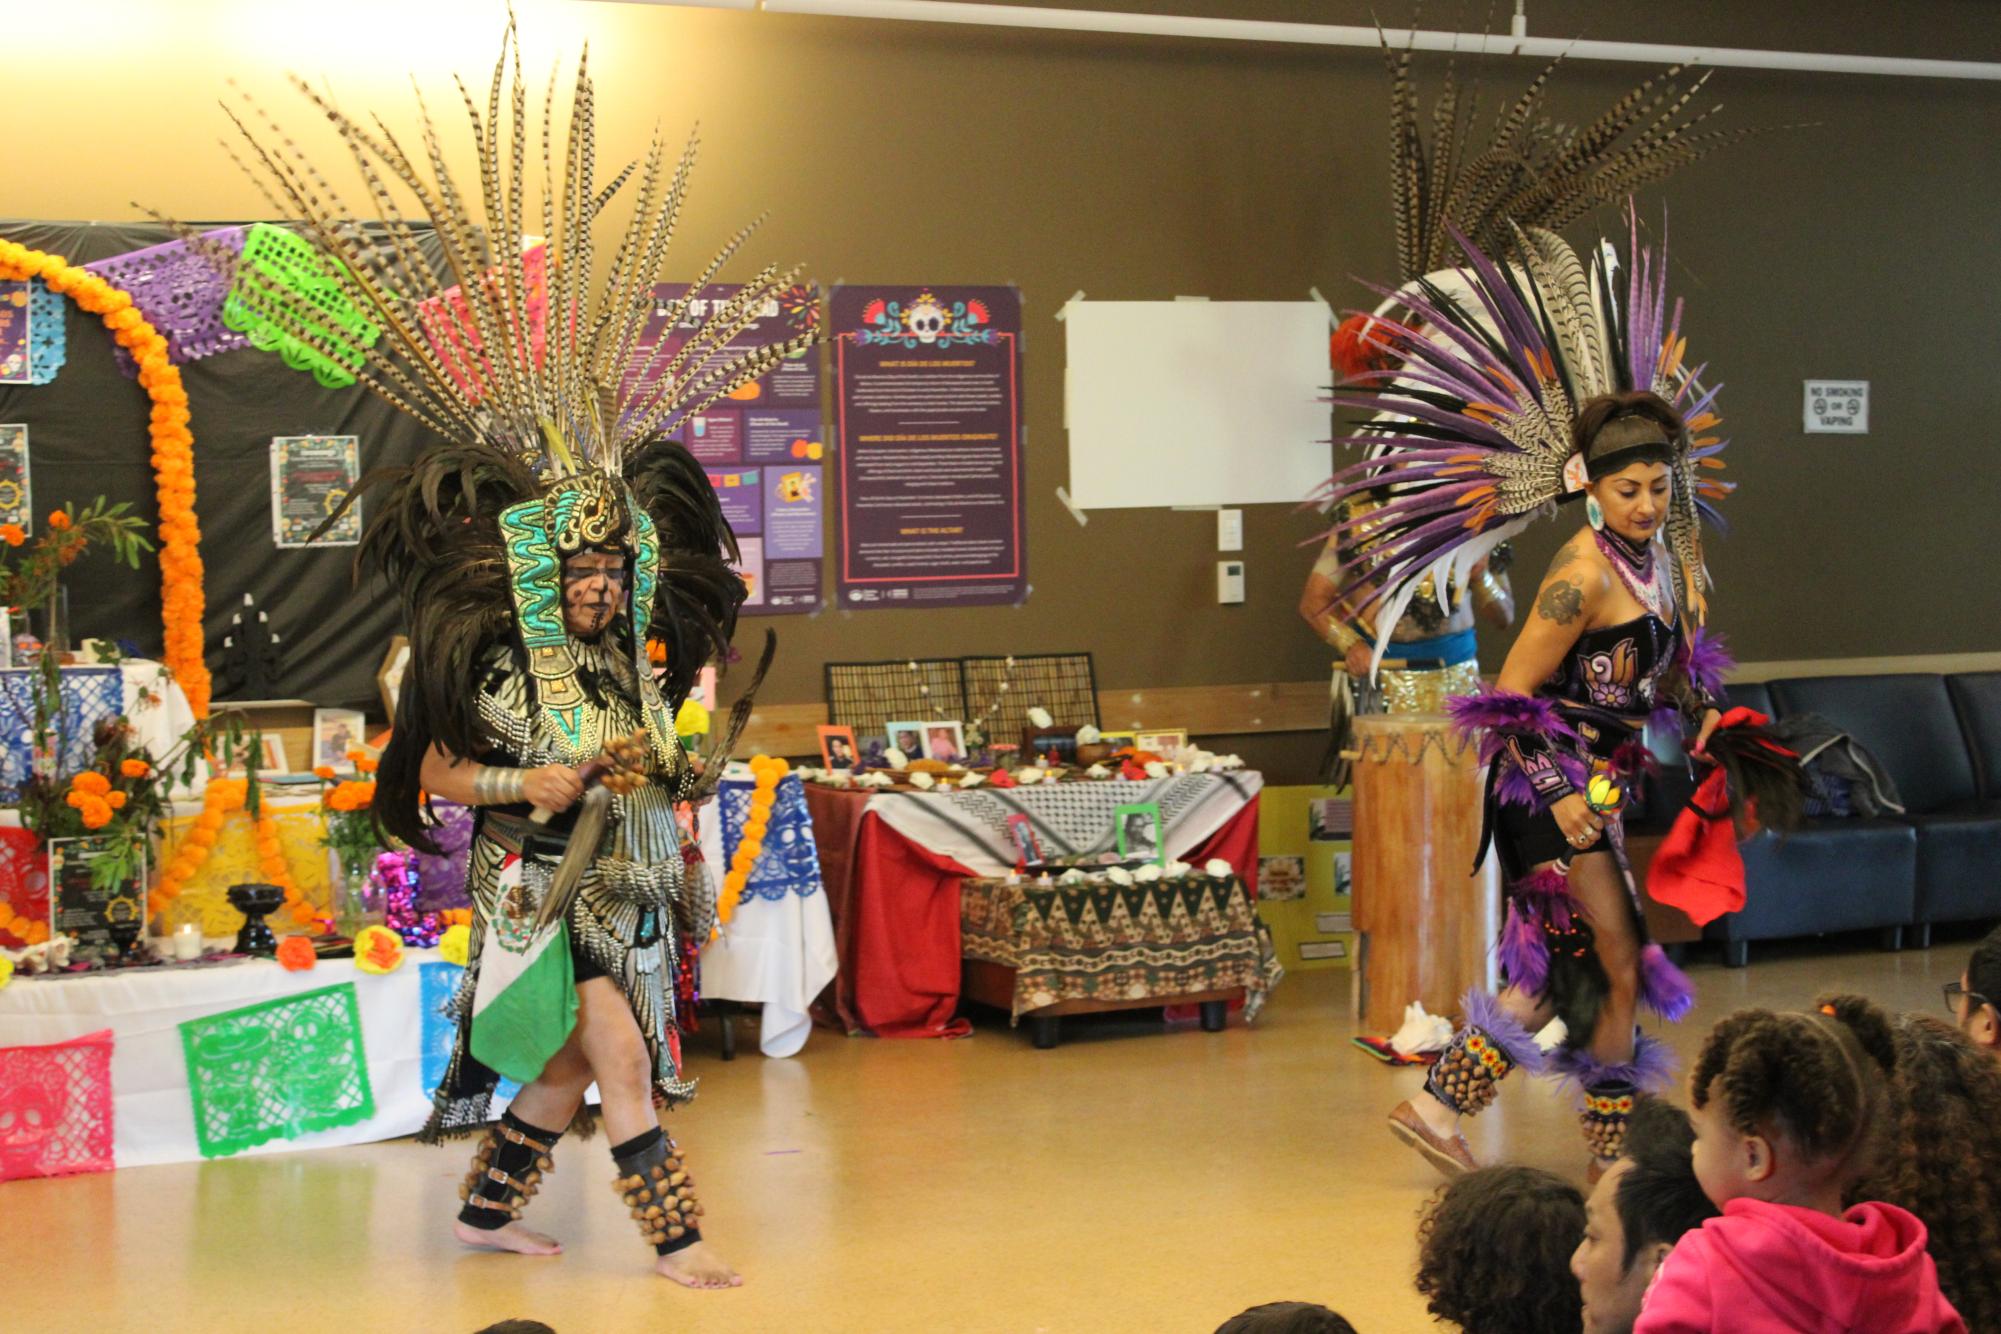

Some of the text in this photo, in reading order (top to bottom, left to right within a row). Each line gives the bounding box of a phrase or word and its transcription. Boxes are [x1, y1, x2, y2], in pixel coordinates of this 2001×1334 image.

[689, 299, 709, 317] OF
[1811, 387, 1863, 398] NO SMOKING
[1831, 402, 1842, 411] OR
[1820, 416, 1853, 426] VAPING
